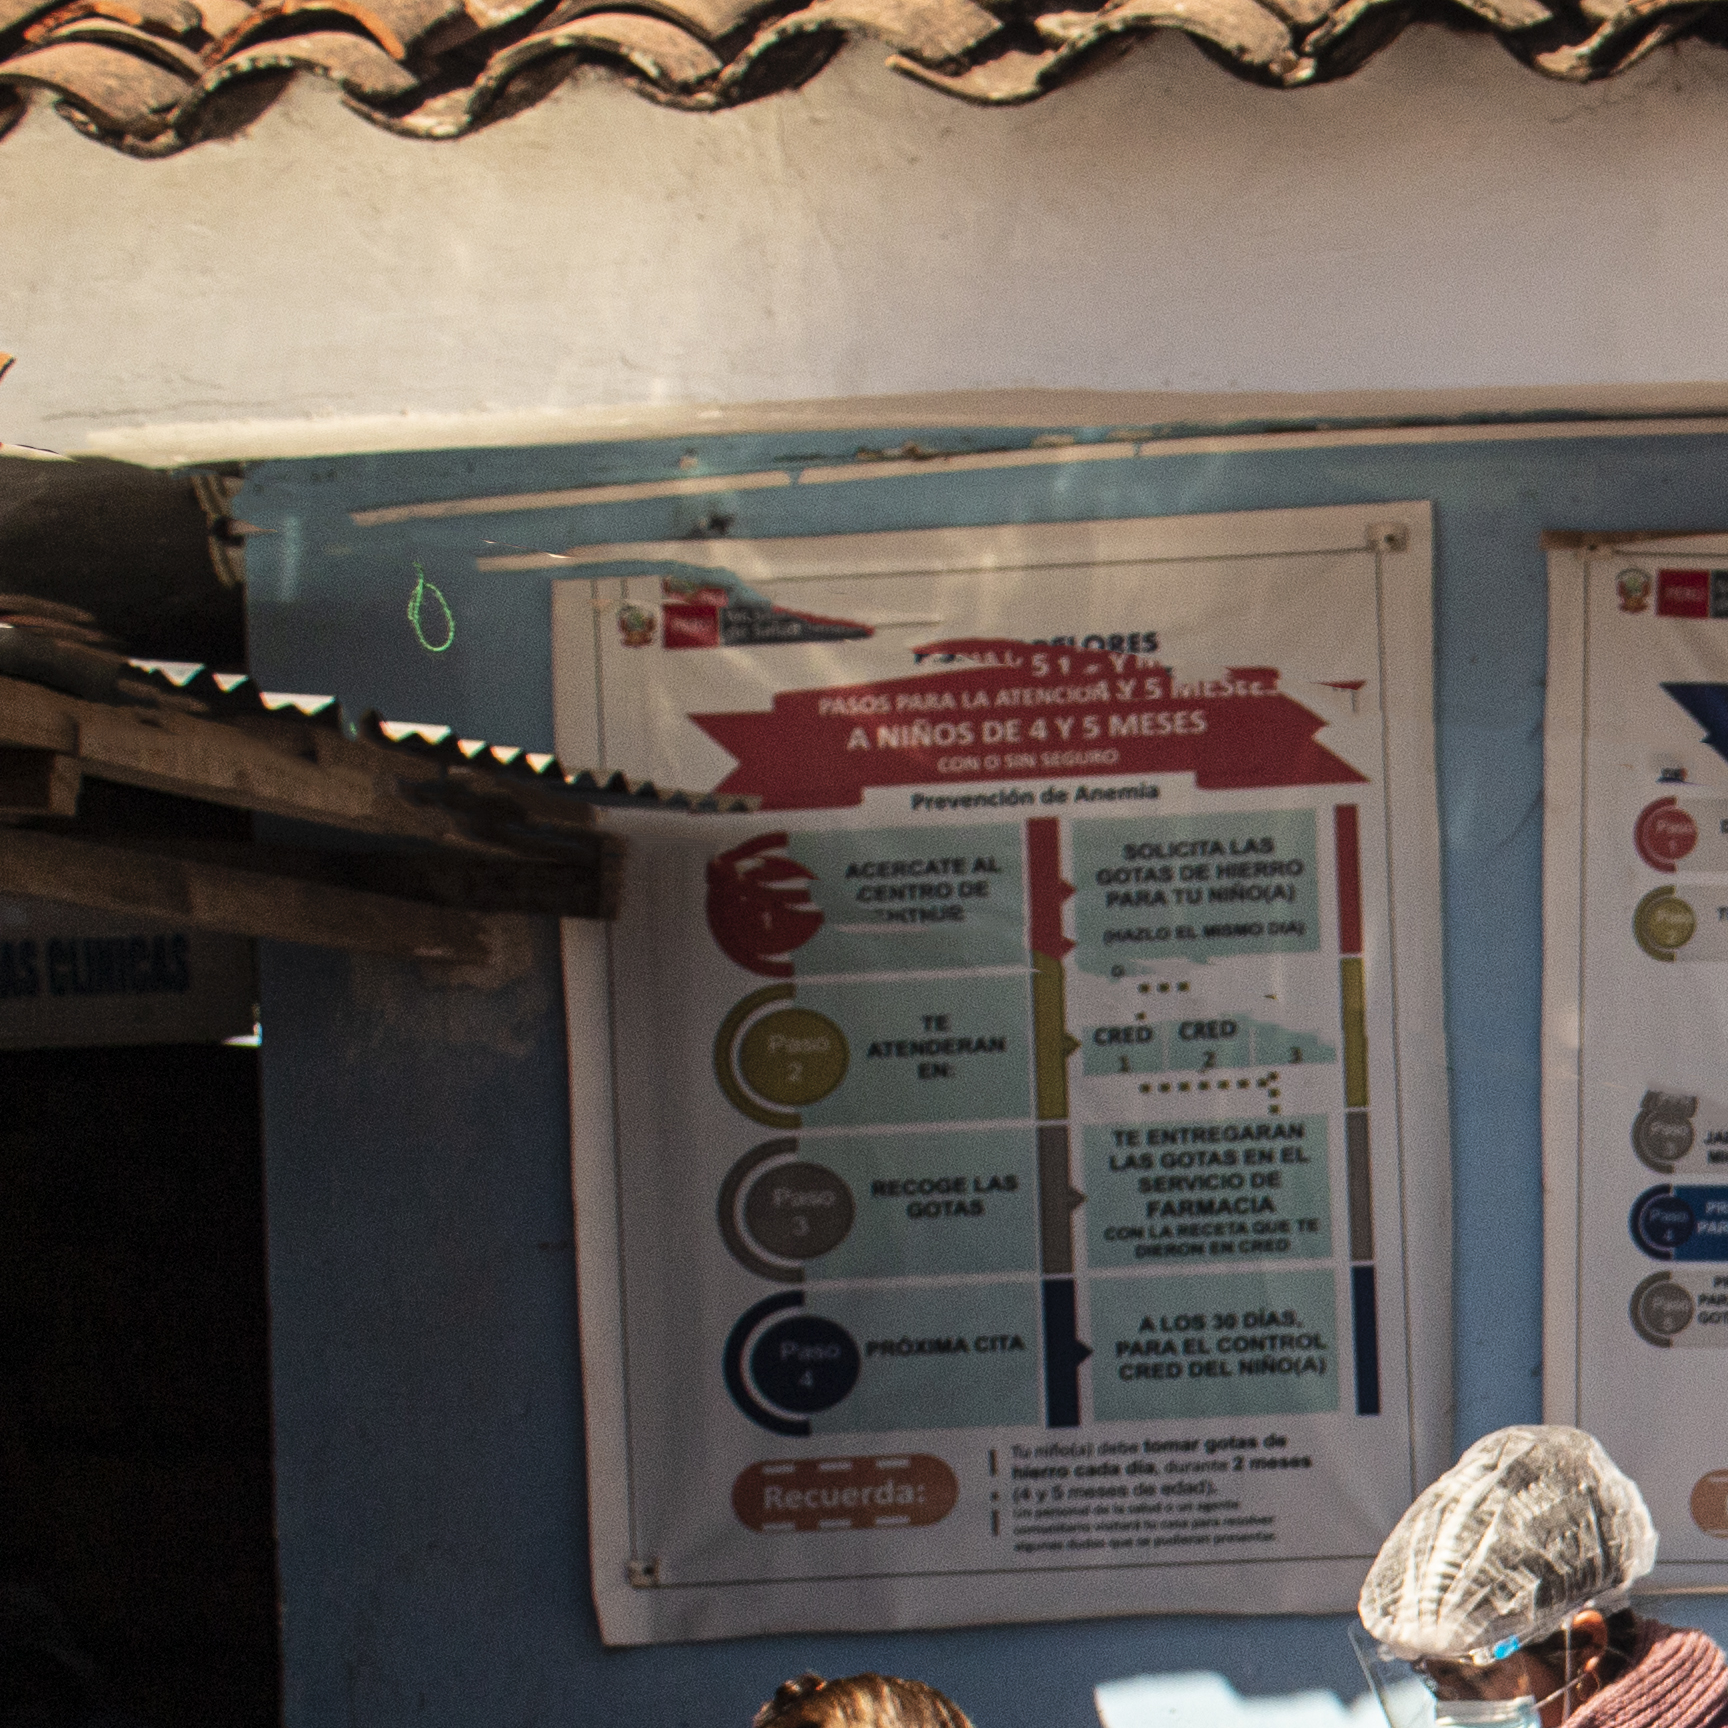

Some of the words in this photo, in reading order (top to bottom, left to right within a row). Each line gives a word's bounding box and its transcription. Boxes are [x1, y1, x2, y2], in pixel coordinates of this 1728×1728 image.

[818, 693, 889, 716] PASOS
[895, 691, 958, 712] PARA
[961, 689, 988, 710] LA
[848, 727, 870, 751] A
[876, 716, 974, 748] NIÑOS
[982, 719, 1018, 744] DE
[1027, 715, 1048, 740] 4
[1054, 714, 1075, 738] Y
[1083, 714, 1101, 738] 5
[1108, 709, 1208, 736] MESES
[937, 755, 980, 774] CON
[1004, 750, 1036, 769] SIN
[1040, 747, 1121, 768] SEGURO
[911, 786, 1034, 810] Prevención
[1040, 784, 1068, 806] de
[1074, 781, 1160, 804] Anemia
[1121, 841, 1226, 862] SOLICITA
[1228, 836, 1277, 856] LAS
[844, 858, 967, 881] ACERCATE
[970, 855, 1003, 876] AL
[1094, 864, 1175, 887] GOTAS
[1177, 862, 1212, 883] DE
[1214, 857, 1307, 880] HIERRO
[855, 880, 954, 903] CENTRO
[957, 878, 991, 900] DE
[1103, 887, 1169, 910] PARA
[1172, 886, 1206, 907] TU
[1206, 880, 1299, 906] NIÑO(A)
[1101, 925, 1172, 948] (HAZLO
[1174, 922, 1200, 942] EL
[1202, 920, 1265, 941] MISMO
[920, 1013, 952, 1034] TE
[1092, 1024, 1156, 1048] CRED
[1177, 1018, 1241, 1043] CRED
[865, 1034, 1008, 1060] ATENDERAN
[1111, 1127, 1141, 1149] TE
[1145, 1121, 1306, 1147] ENTREGARAN
[1107, 1151, 1156, 1174] LAS
[1158, 1147, 1241, 1173] GOTAS
[1242, 1146, 1276, 1168] EN
[1278, 1144, 1313, 1165] EL
[869, 1175, 969, 1199] RECOGE
[971, 1172, 1021, 1195] LAS
[1136, 1171, 1246, 1195] SERVICIO
[1248, 1169, 1283, 1190] DE
[904, 1197, 986, 1221] GOTAS
[1145, 1194, 1279, 1220] FARMACIA
[1102, 1225, 1146, 1243] CON
[1147, 1223, 1174, 1241] LA
[1175, 1220, 1249, 1239] RECETA
[1252, 1218, 1293, 1236] QUE
[1295, 1215, 1322, 1235] TE
[1137, 1314, 1158, 1336] A
[1159, 1312, 1209, 1334] LOS
[1211, 1310, 1239, 1332] 30
[865, 1334, 970, 1359] PRÓXIMA
[972, 1333, 1028, 1355] CITA
[1114, 1337, 1180, 1360] PARA
[1181, 1335, 1212, 1358] EL
[1214, 1330, 1330, 1355] CONTROL
[1117, 1360, 1185, 1383] CRED
[1186, 1358, 1235, 1380] DEL
[1236, 1353, 1329, 1379] NIÑO(A)
[1097, 1440, 1141, 1456] debe
[1142, 1437, 1201, 1455] tomar
[1203, 1435, 1260, 1456] gotas
[1262, 1433, 1289, 1450] de
[1011, 1464, 1070, 1480] hierro
[1072, 1461, 1122, 1478] cada
[1162, 1459, 1230, 1475] durante
[1248, 1455, 1314, 1472] meses
[764, 1480, 925, 1509] Recuerda:
[1067, 1485, 1130, 1500] meses
[1132, 1482, 1158, 1498] de
